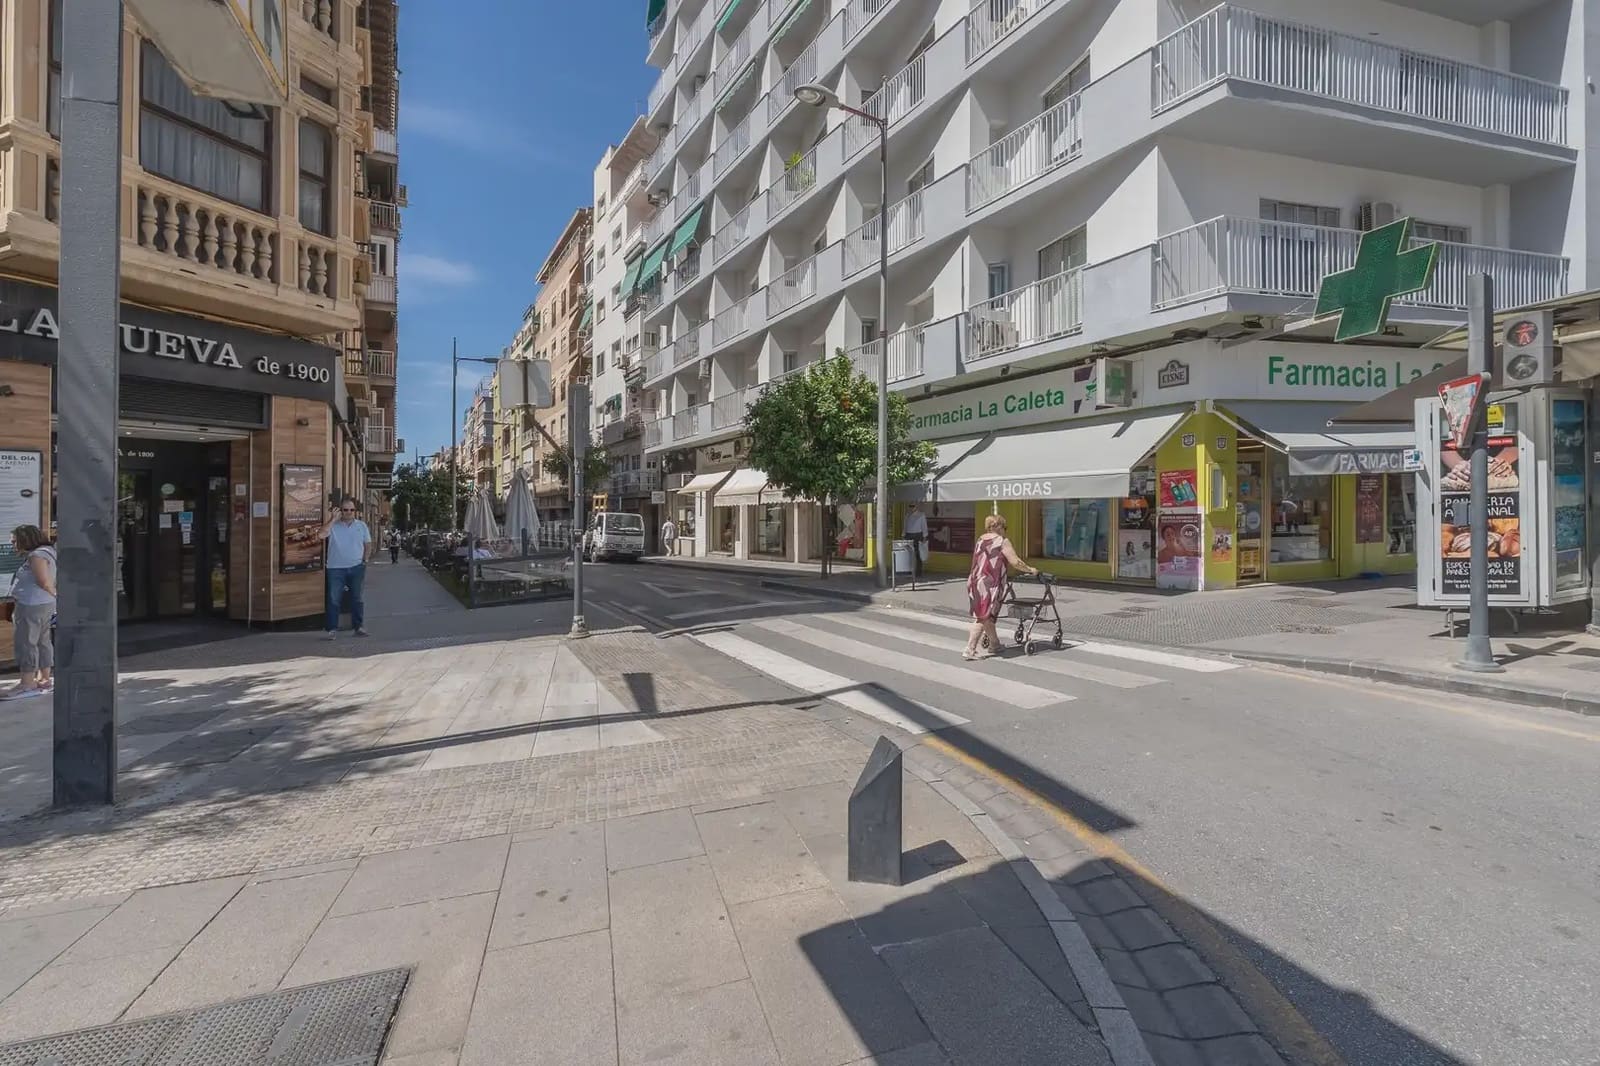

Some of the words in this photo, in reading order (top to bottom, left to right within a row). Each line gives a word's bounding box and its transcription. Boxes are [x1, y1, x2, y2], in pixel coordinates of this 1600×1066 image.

[257, 356, 280, 375] de
[287, 363, 330, 383] 1900
[1268, 356, 1387, 388] Farmacia
[909, 404, 973, 431] Farmacia
[978, 401, 999, 418] La
[1003, 388, 1065, 414] Caleta
[1340, 452, 1404, 473] FARMACI
[985, 484, 1000, 498] 13
[1002, 481, 1053, 497] HORAS
